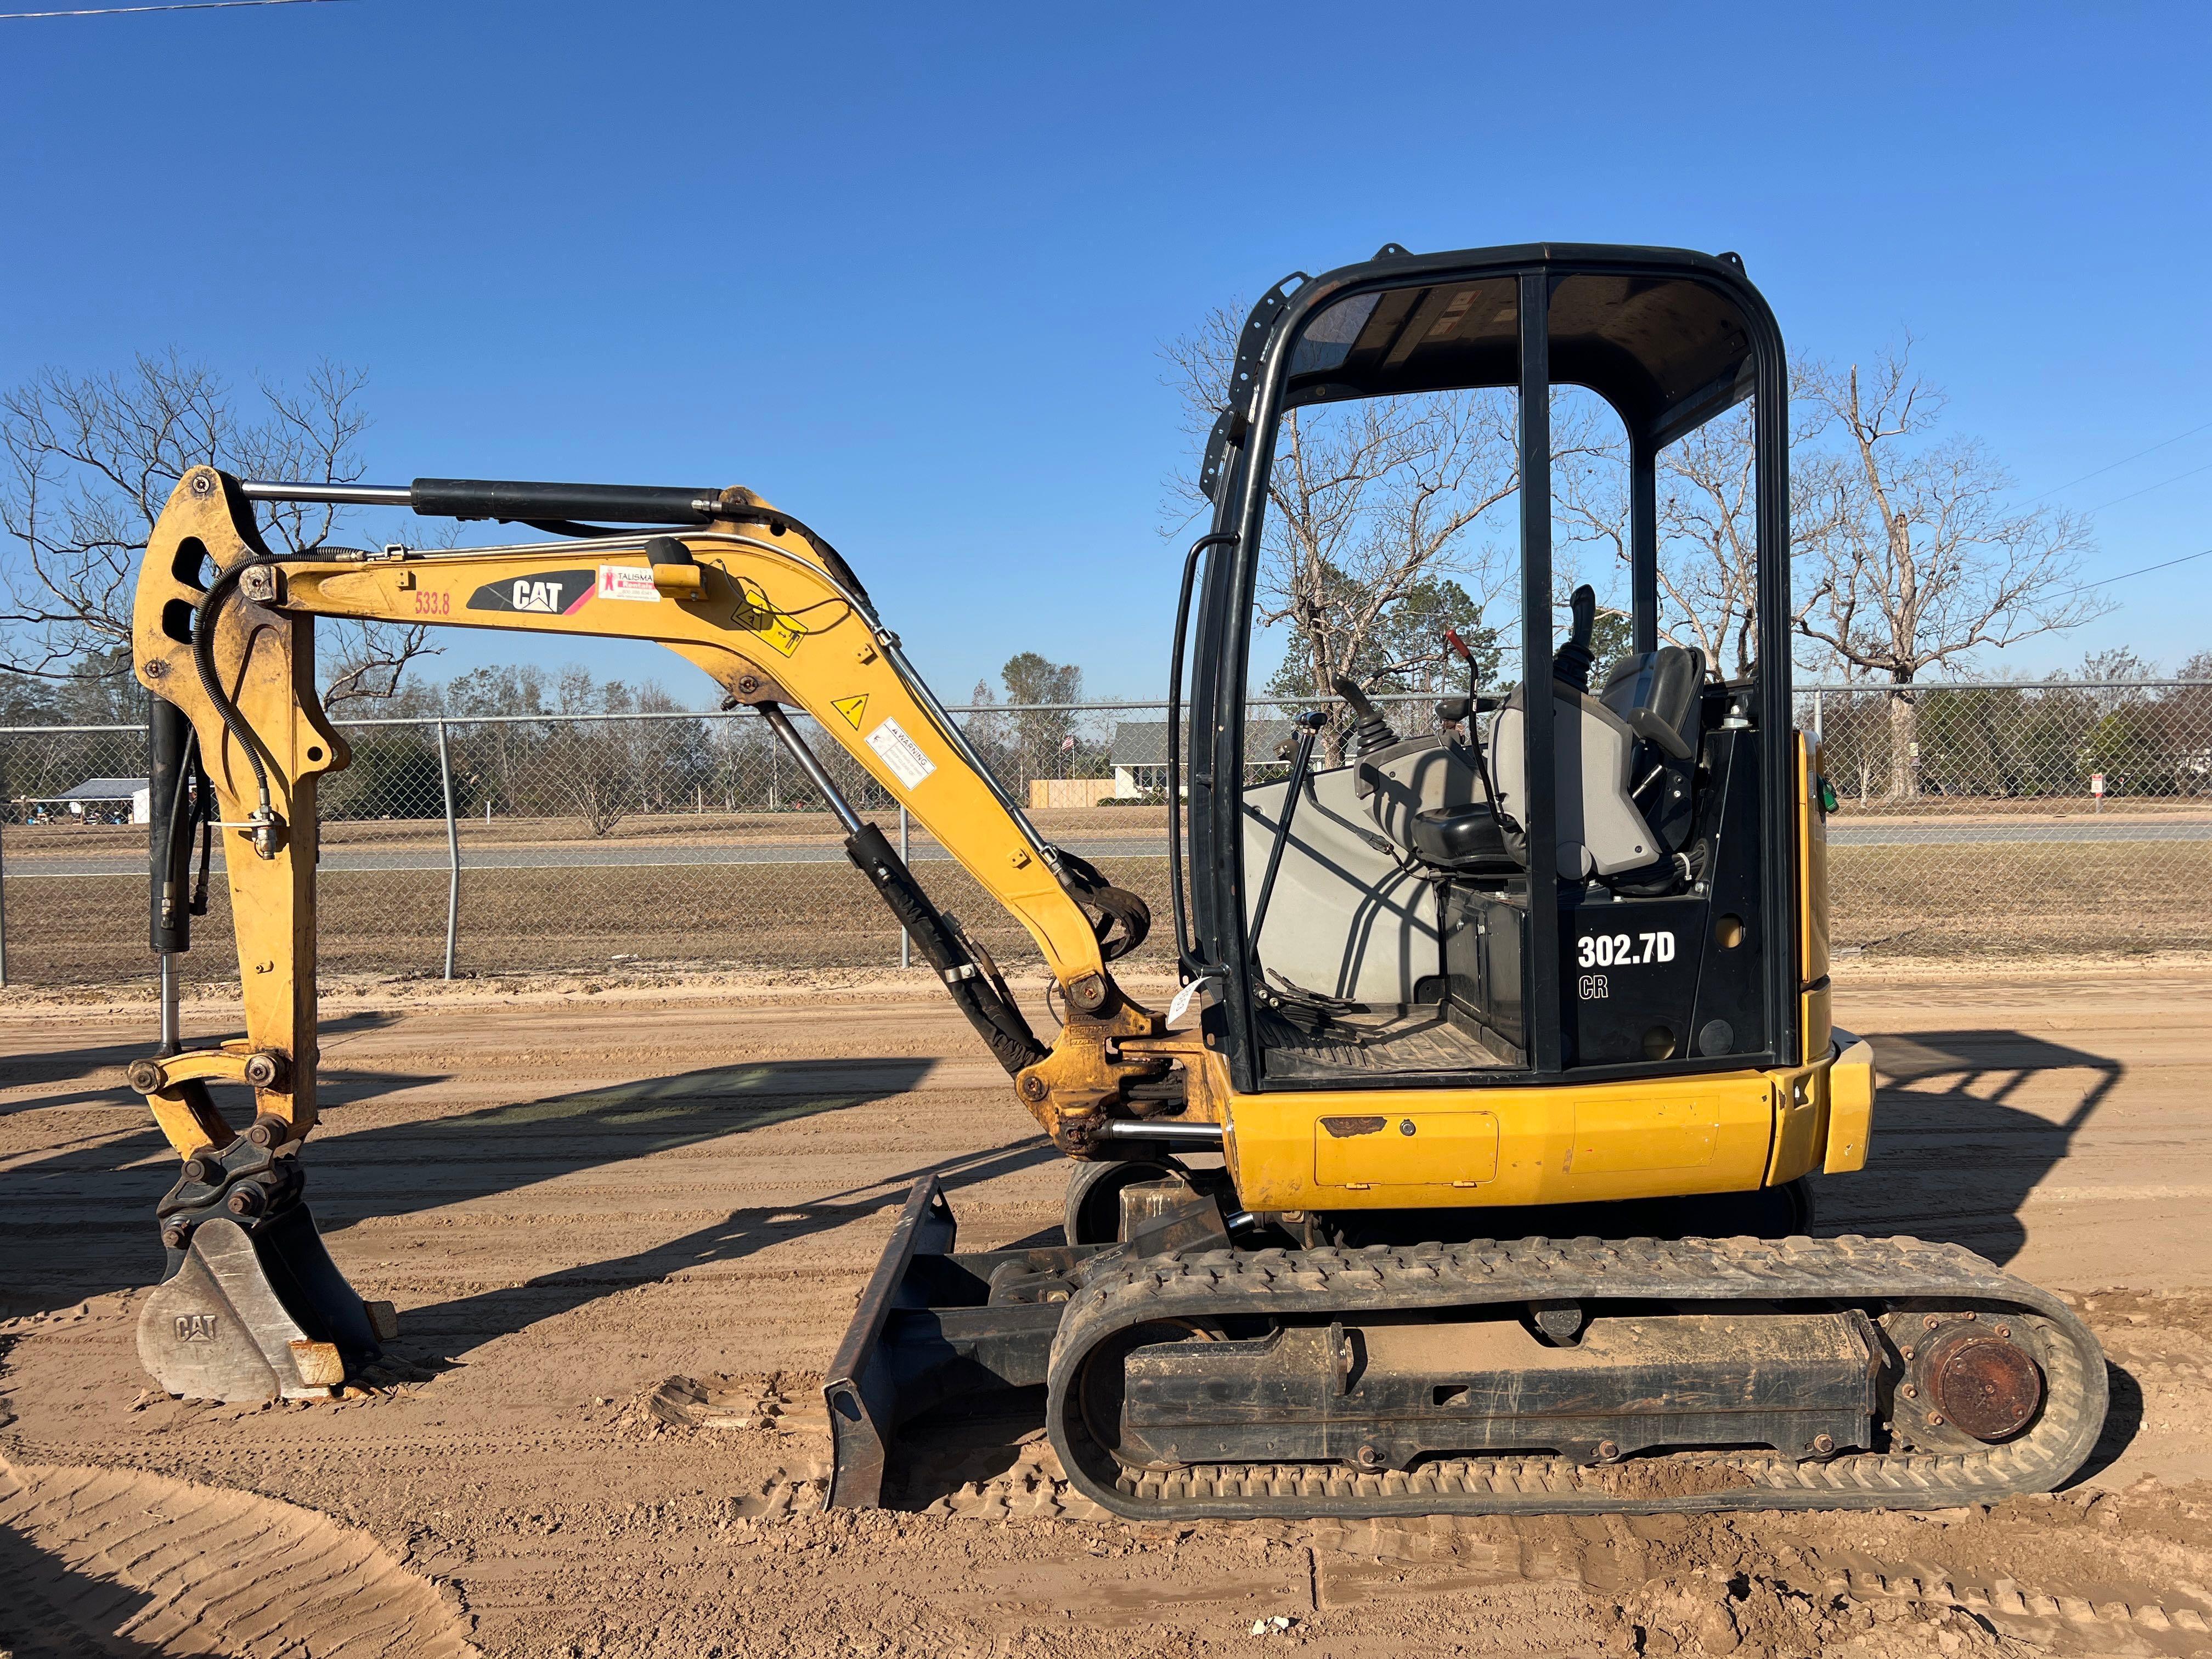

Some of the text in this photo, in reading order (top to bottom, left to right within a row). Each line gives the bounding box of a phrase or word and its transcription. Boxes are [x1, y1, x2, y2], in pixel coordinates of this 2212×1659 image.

[618, 573, 653, 582] TALISMA
[623, 581, 653, 589] Rentals
[415, 591, 450, 615] 533.8
[512, 580, 563, 613] CAT
[898, 733, 927, 765] WARNING
[1578, 932, 1675, 968] 302.7D
[1579, 975, 1609, 1000] CR
[176, 1315, 216, 1342] CAT
